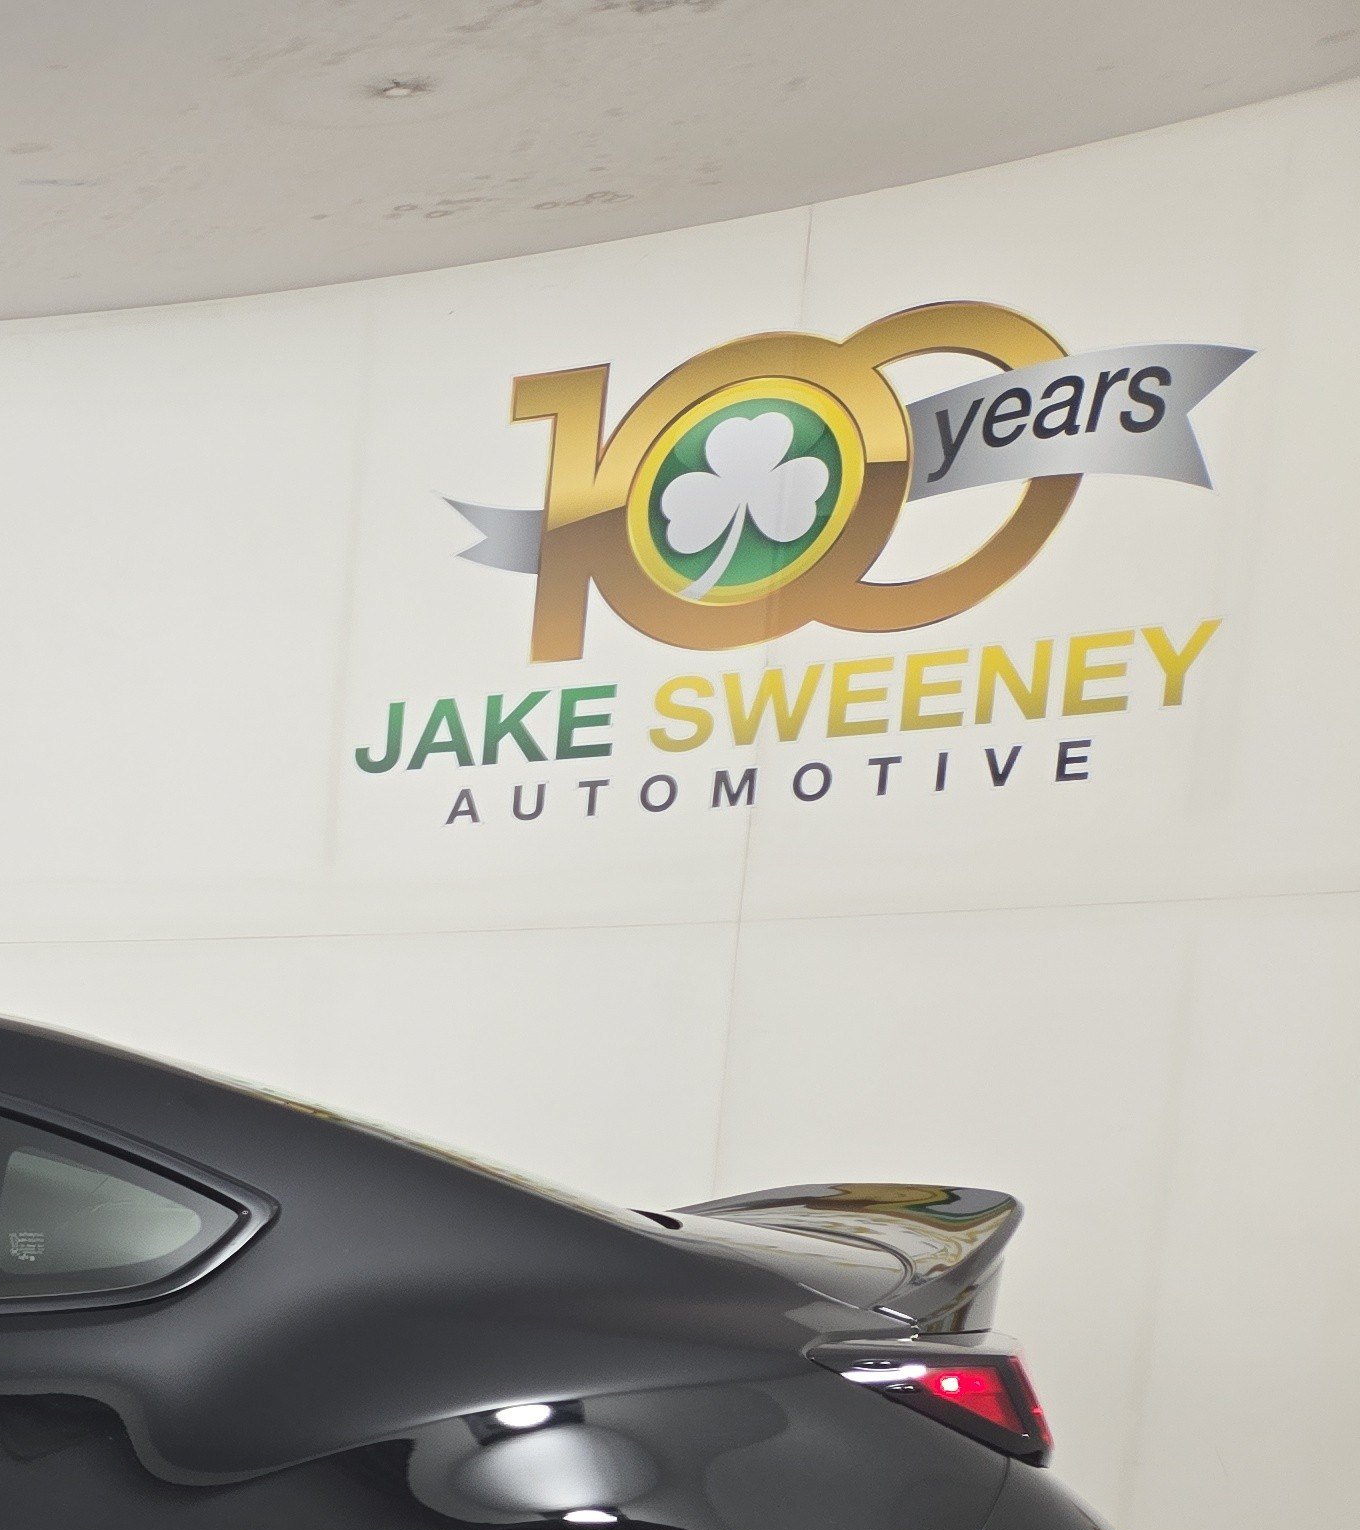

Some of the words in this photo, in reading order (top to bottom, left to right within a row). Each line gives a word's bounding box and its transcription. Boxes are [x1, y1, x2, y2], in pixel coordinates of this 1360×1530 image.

[511, 300, 1085, 664] 100
[927, 363, 1173, 484] years
[354, 683, 619, 775] JAKE
[648, 619, 1224, 754] SWEENEY
[446, 739, 1094, 826] AUTOMOTIVE
